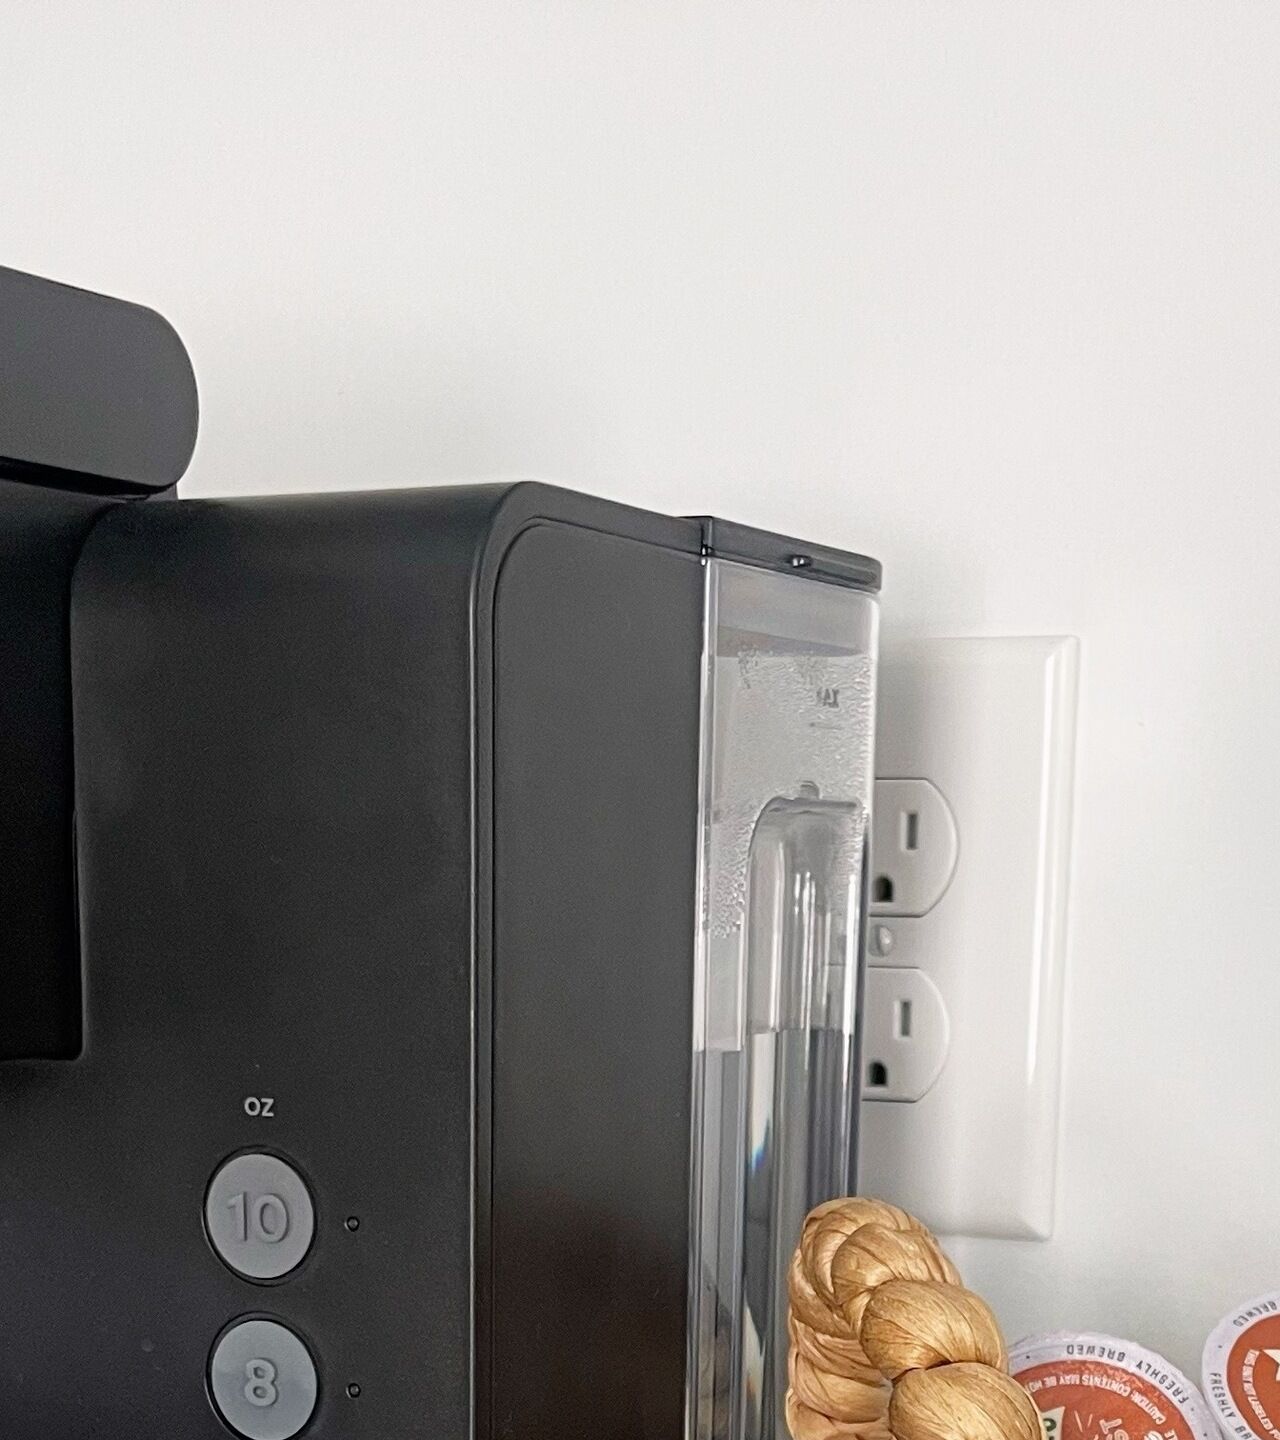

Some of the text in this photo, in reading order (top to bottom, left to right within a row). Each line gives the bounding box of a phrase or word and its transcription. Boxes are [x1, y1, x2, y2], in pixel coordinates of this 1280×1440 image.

[244, 1097, 274, 1117] OZ
[227, 1193, 291, 1245] 10
[1066, 1344, 1126, 1363] BREWED
[244, 1357, 278, 1407] 8
[1210, 1372, 1236, 1420] FRESHLY
